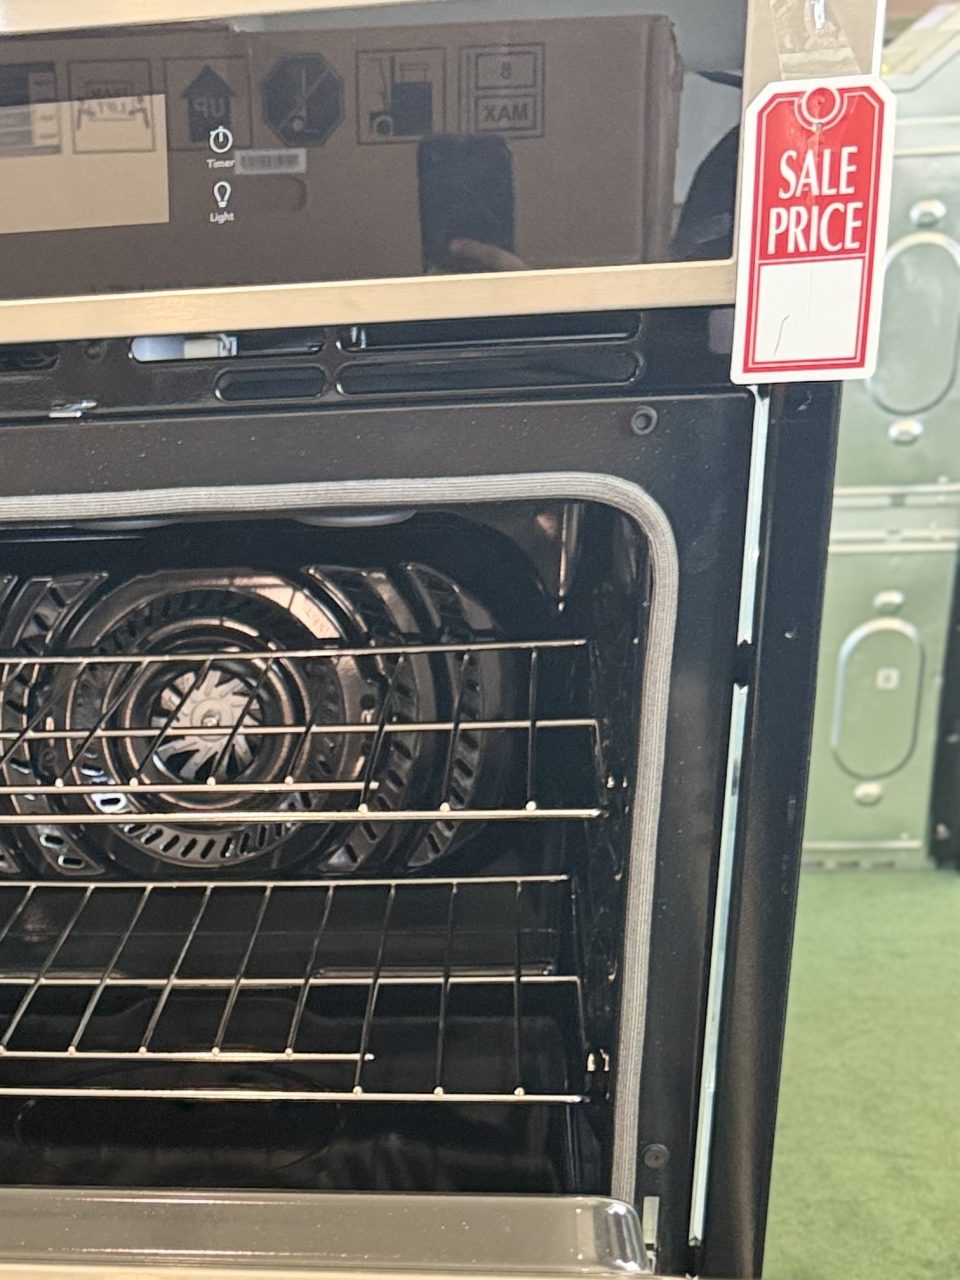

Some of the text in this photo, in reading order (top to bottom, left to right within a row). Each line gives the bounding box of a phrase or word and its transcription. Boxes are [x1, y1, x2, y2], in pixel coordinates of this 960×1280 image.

[206, 158, 236, 170] Timer
[778, 145, 859, 200] SALE
[209, 211, 235, 225] Light
[767, 201, 864, 255] PRICE
